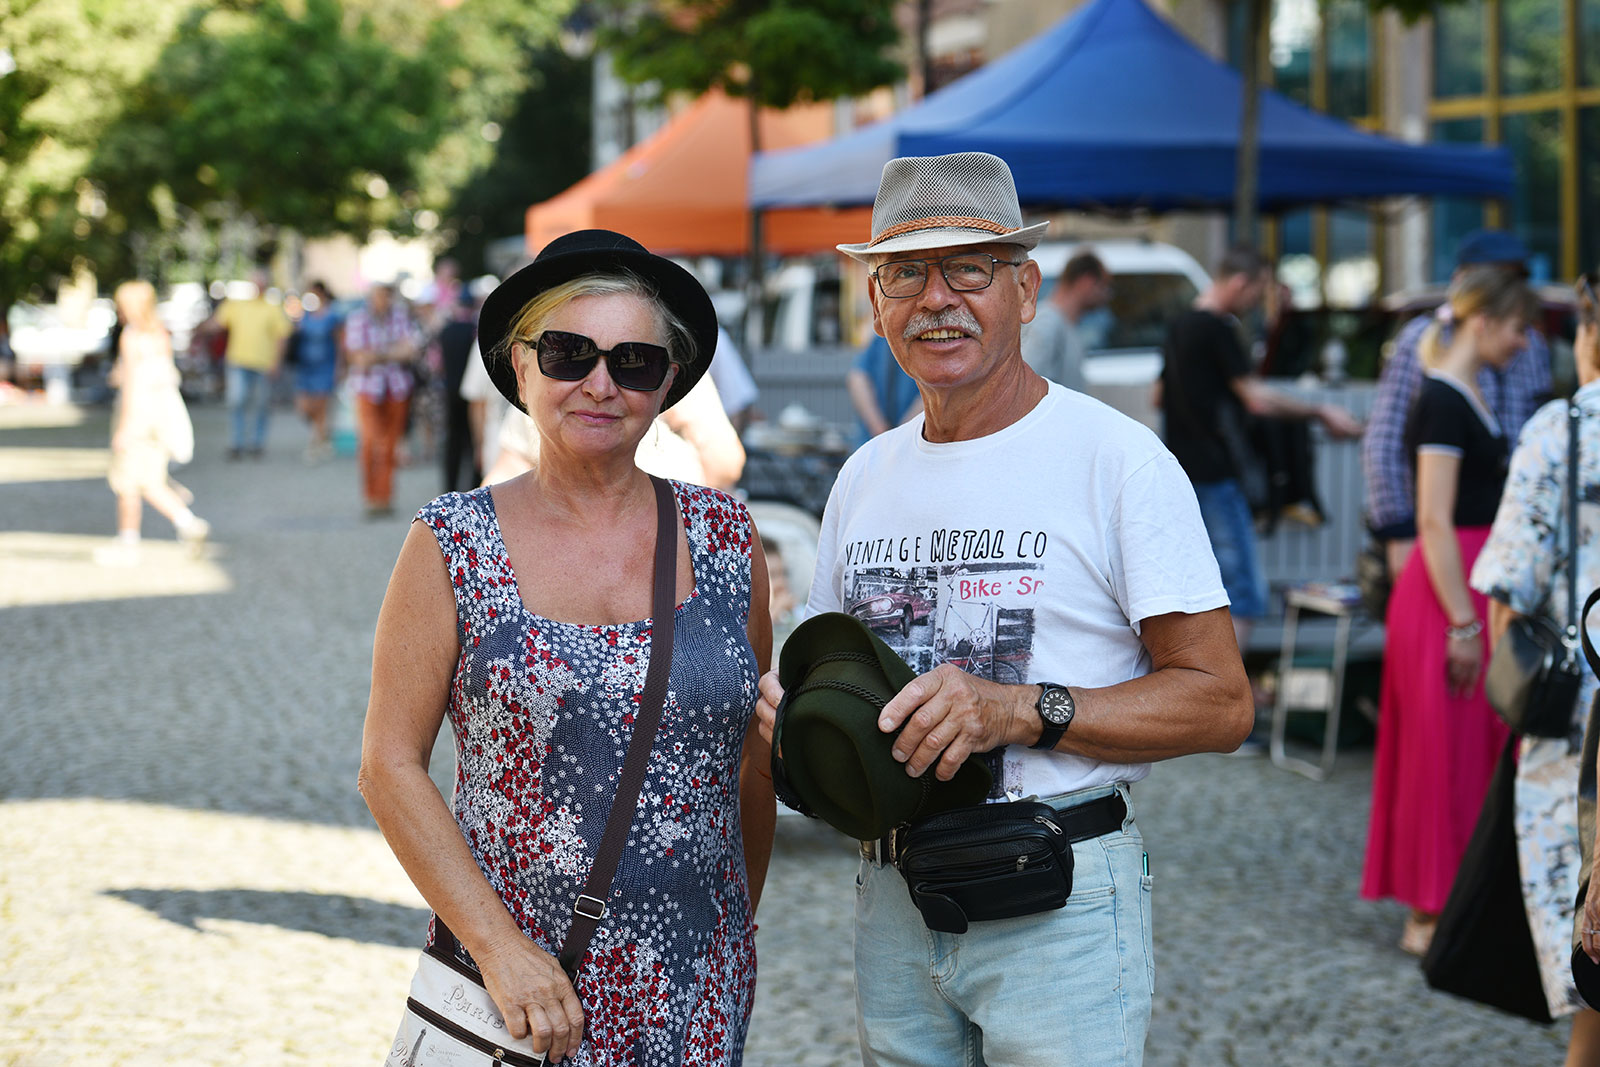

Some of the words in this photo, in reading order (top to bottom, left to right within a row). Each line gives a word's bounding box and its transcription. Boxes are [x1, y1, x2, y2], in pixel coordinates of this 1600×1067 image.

[845, 536, 922, 566] VINTAGE
[930, 528, 1004, 562] METAL
[1017, 530, 1047, 558] CO
[959, 578, 1002, 600] Bike
